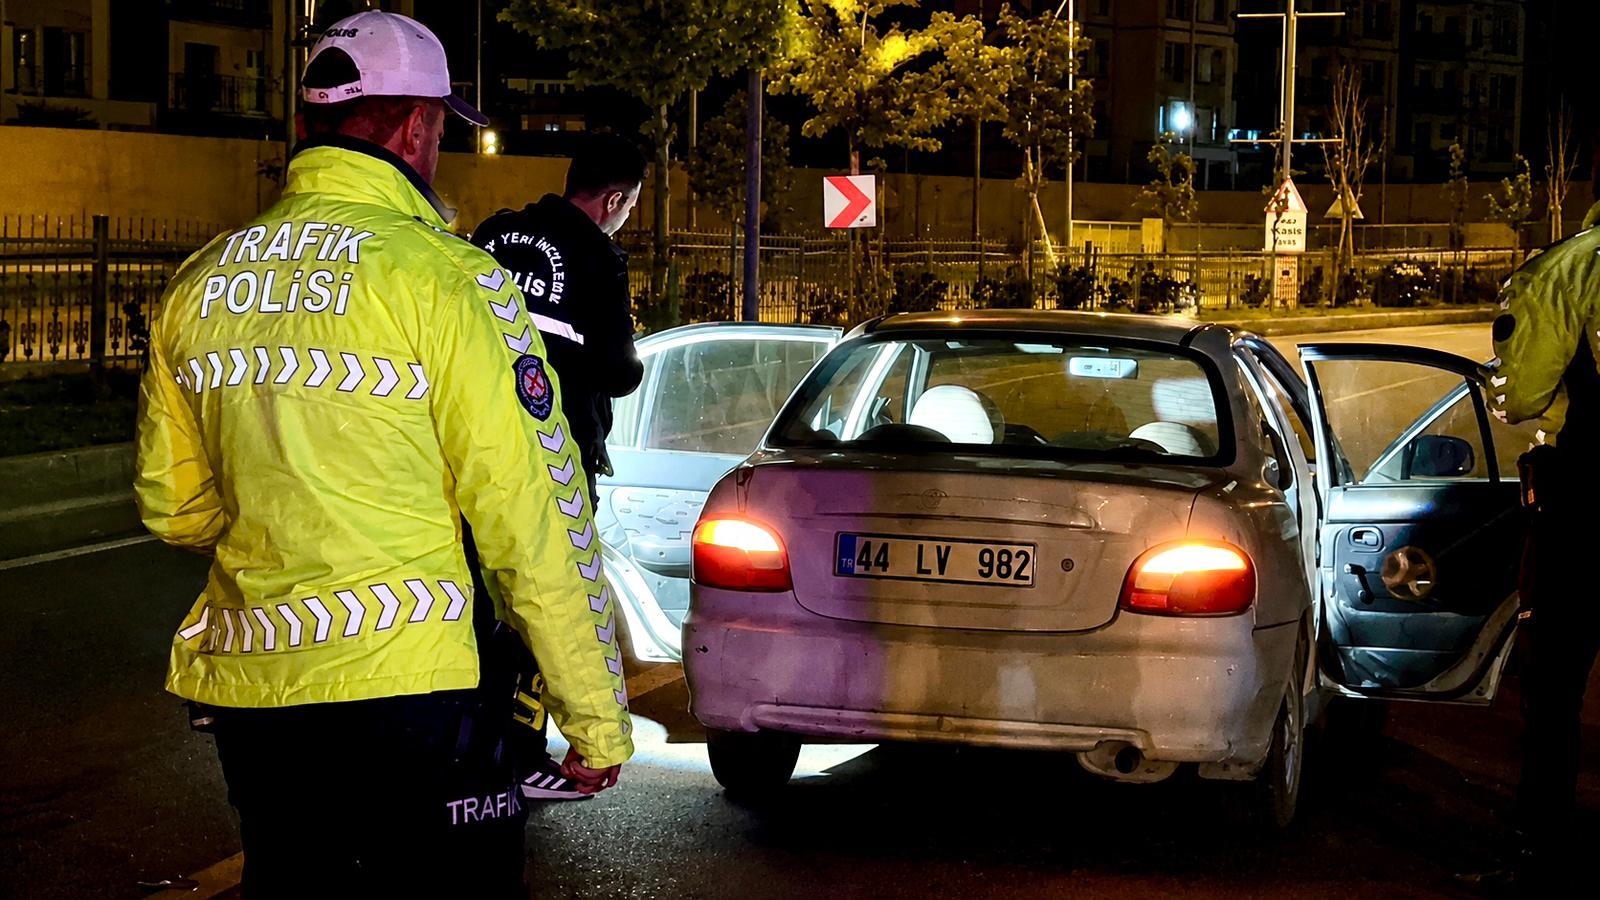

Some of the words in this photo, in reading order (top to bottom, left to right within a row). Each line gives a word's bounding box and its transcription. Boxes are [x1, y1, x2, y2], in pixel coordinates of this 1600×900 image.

[841, 558, 853, 568] TR
[856, 541, 889, 572] 44
[916, 544, 951, 575] LV
[978, 548, 1030, 580] 982
